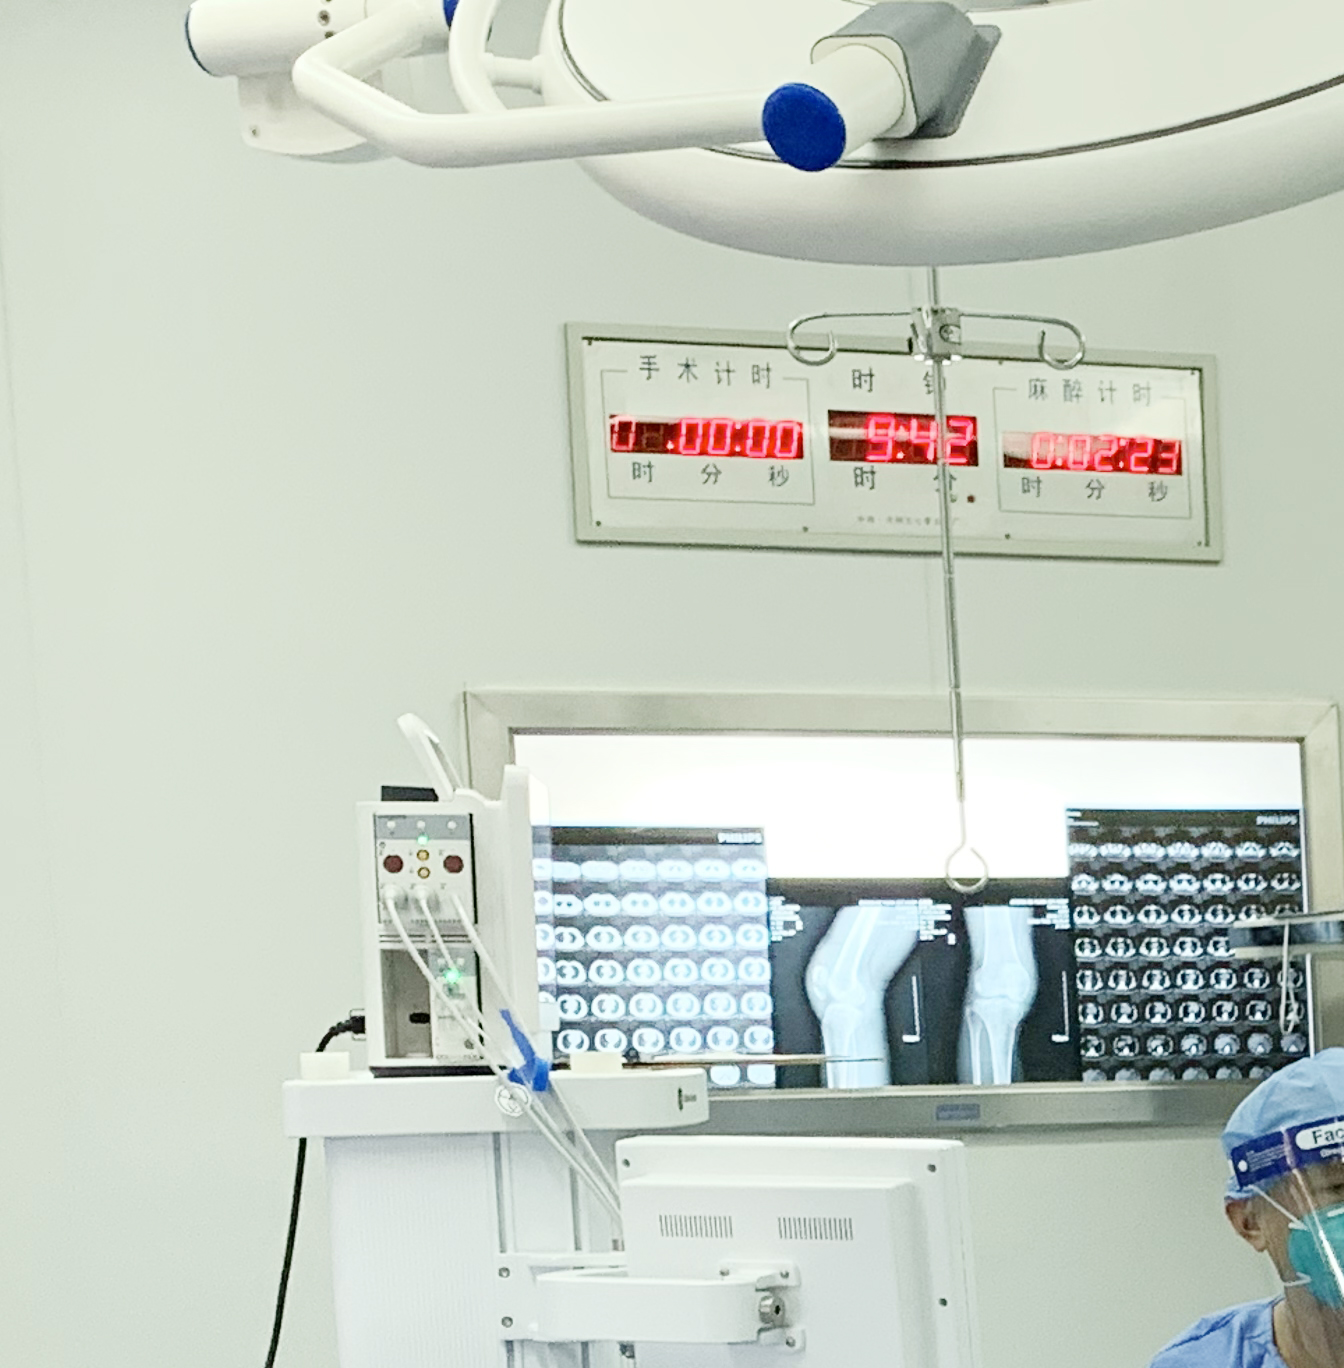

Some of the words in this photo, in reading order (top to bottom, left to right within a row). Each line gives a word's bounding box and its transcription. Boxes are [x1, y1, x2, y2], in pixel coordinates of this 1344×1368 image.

[639, 354, 773, 389] 手术计时
[1028, 377, 1152, 407] 麻醉计时
[631, 461, 654, 482] 时
[701, 462, 722, 485] 分
[768, 465, 789, 486] 秒
[853, 465, 876, 490] 时
[1021, 476, 1042, 498] 时
[1085, 478, 1105, 500] 分
[1256, 815, 1298, 826] PHILIPS
[717, 832, 763, 844] PHILIPS
